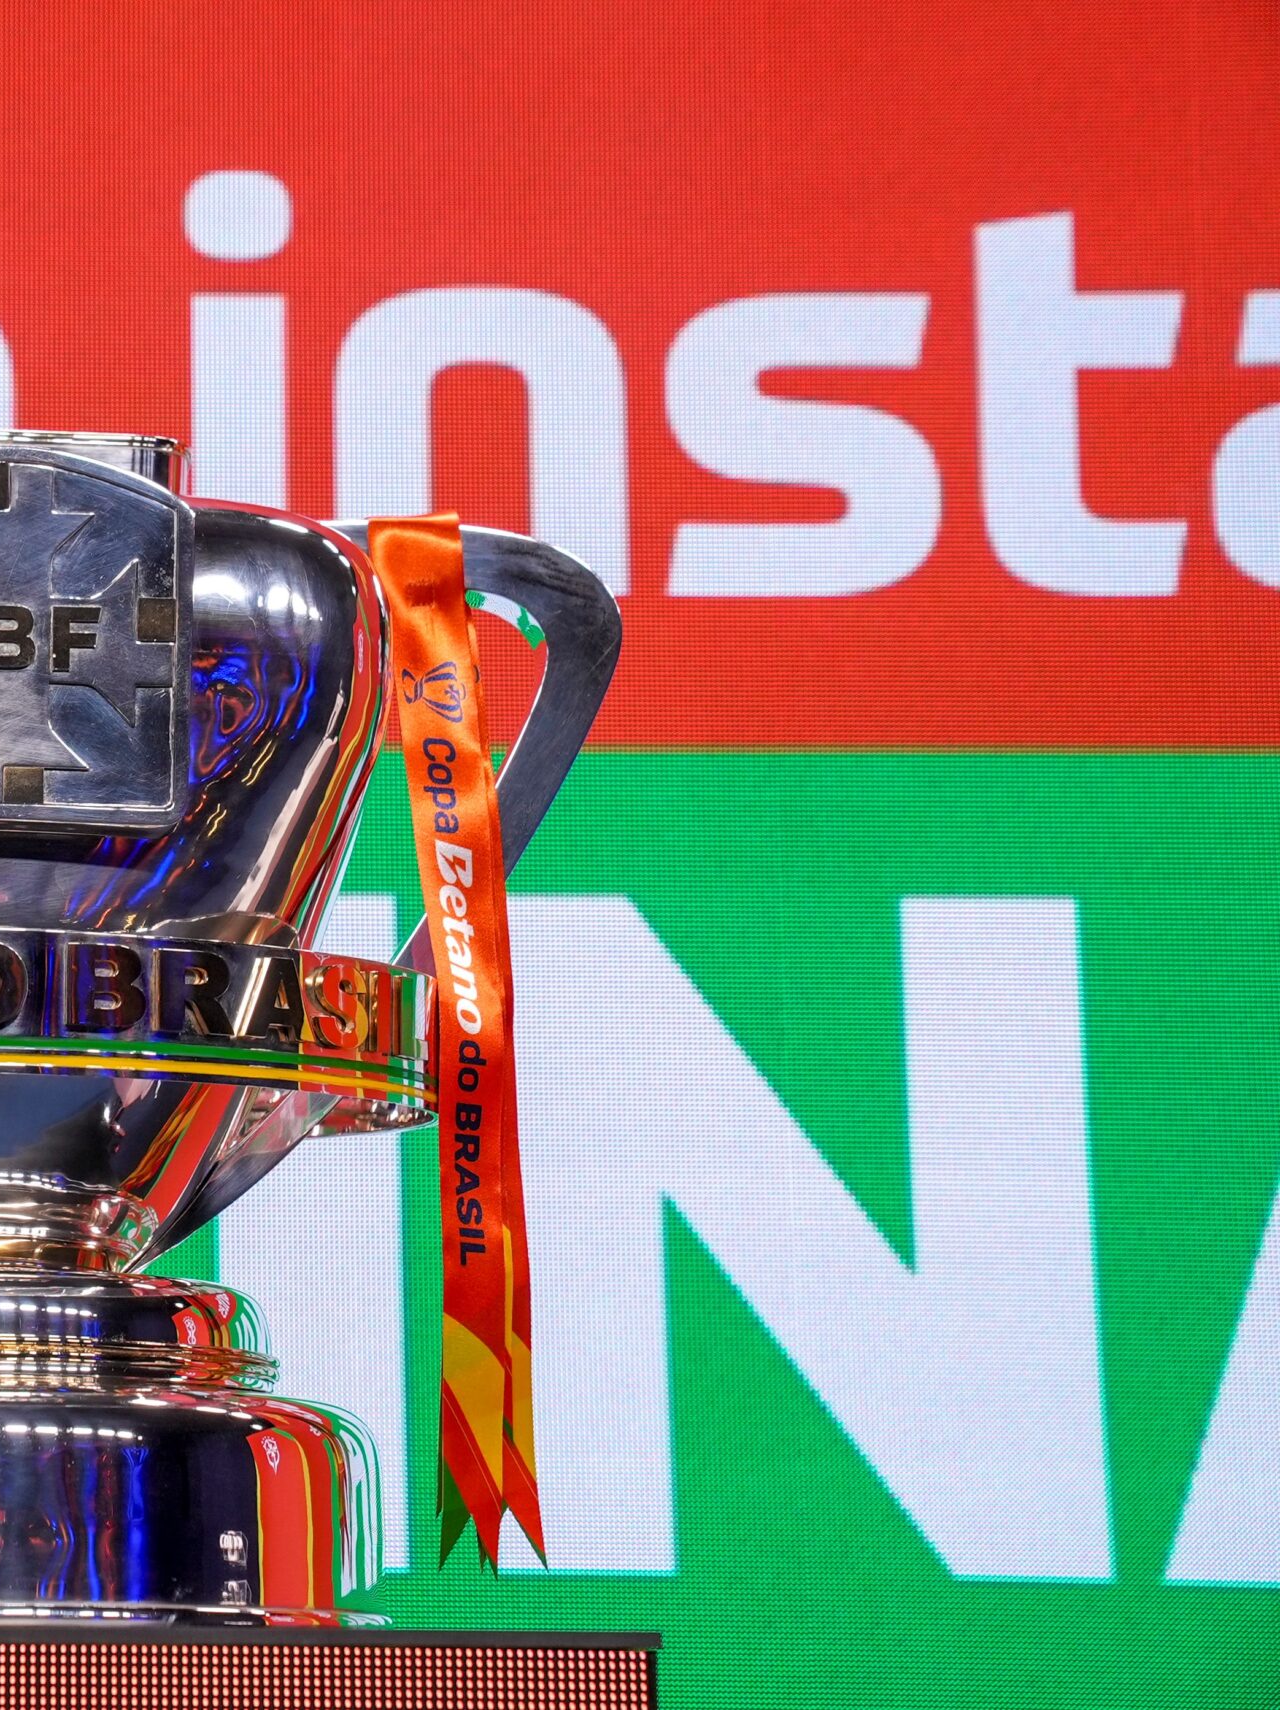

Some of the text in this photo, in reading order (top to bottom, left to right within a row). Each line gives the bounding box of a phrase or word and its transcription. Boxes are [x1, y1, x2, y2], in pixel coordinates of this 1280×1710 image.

[183, 169, 1280, 598] inst
[63, 940, 430, 1062] BRASIL
[422, 737, 487, 1267] Copa Betano do BRASIL
